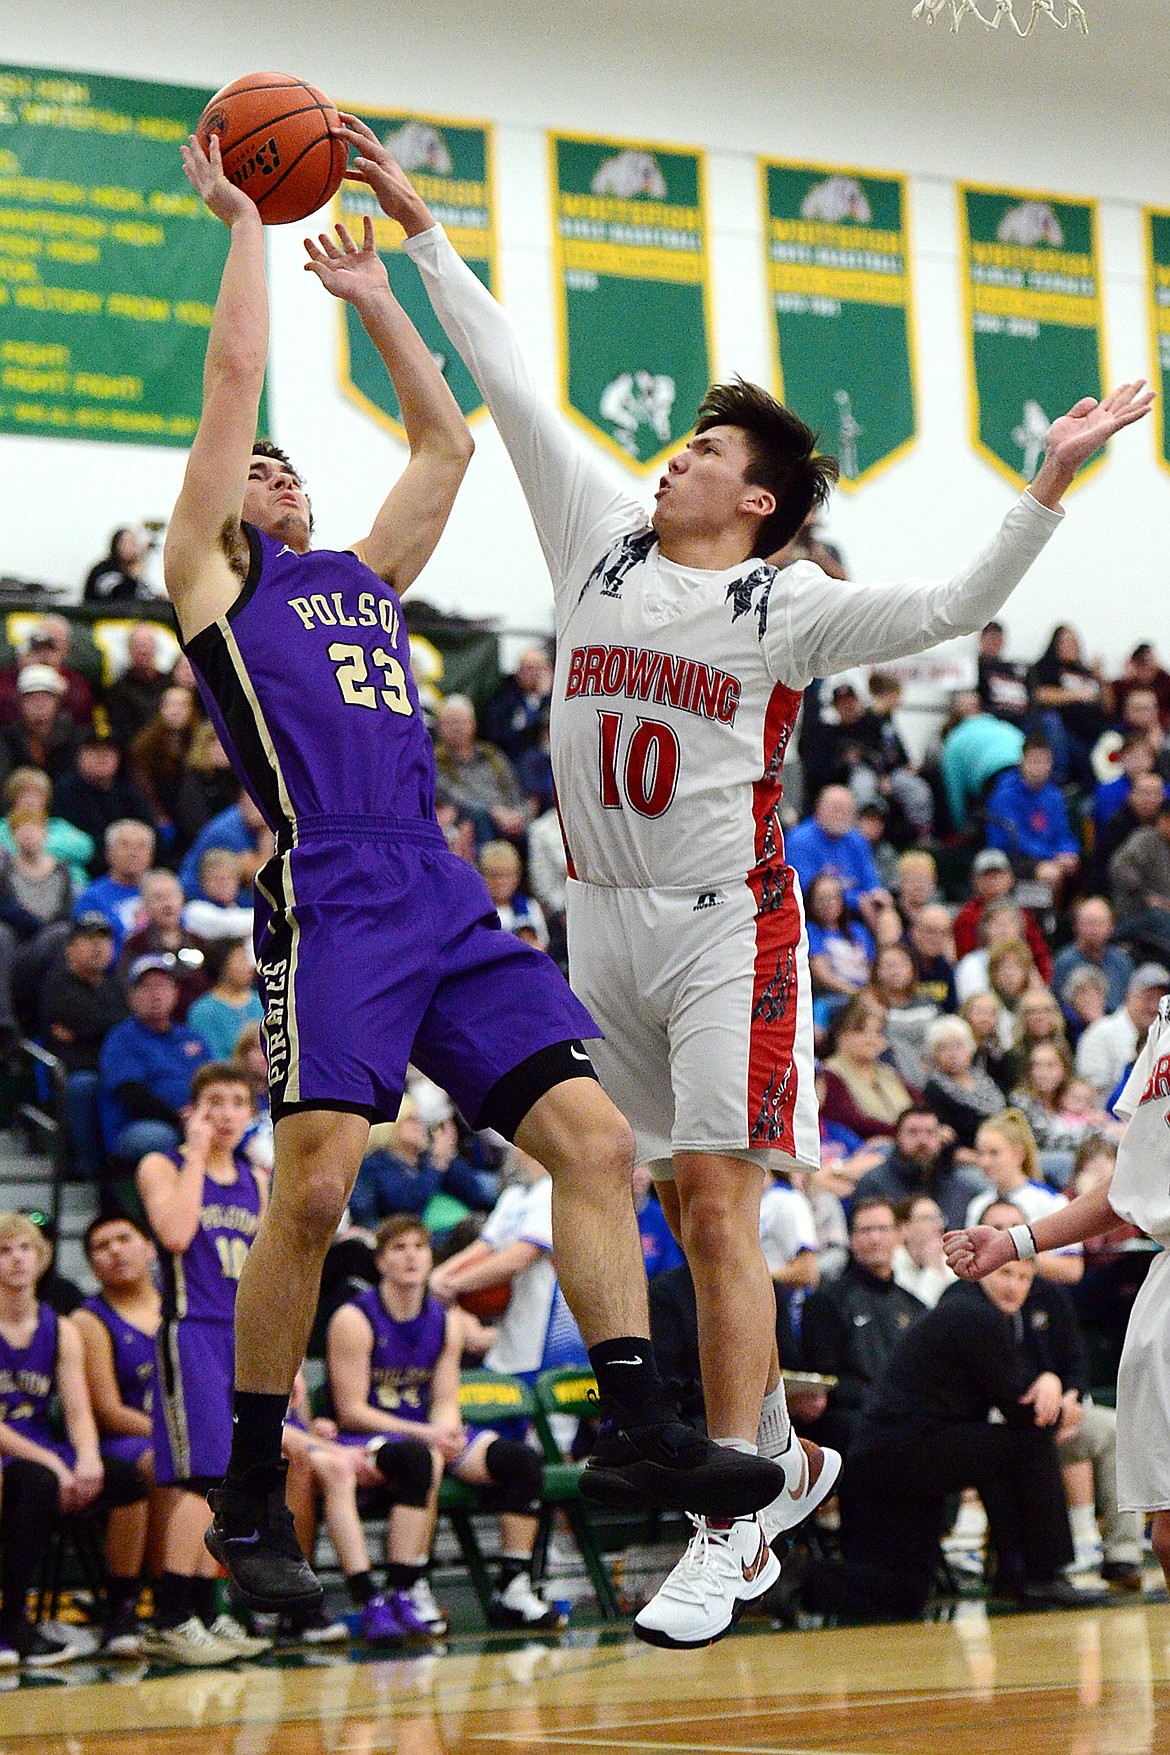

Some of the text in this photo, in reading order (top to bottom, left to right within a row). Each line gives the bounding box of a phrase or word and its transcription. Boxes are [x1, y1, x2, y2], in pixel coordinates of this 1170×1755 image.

[327, 641, 415, 717] 23
[565, 645, 742, 728] BROWNING
[596, 709, 681, 820] 10
[263, 958, 288, 1088] PIRATES
